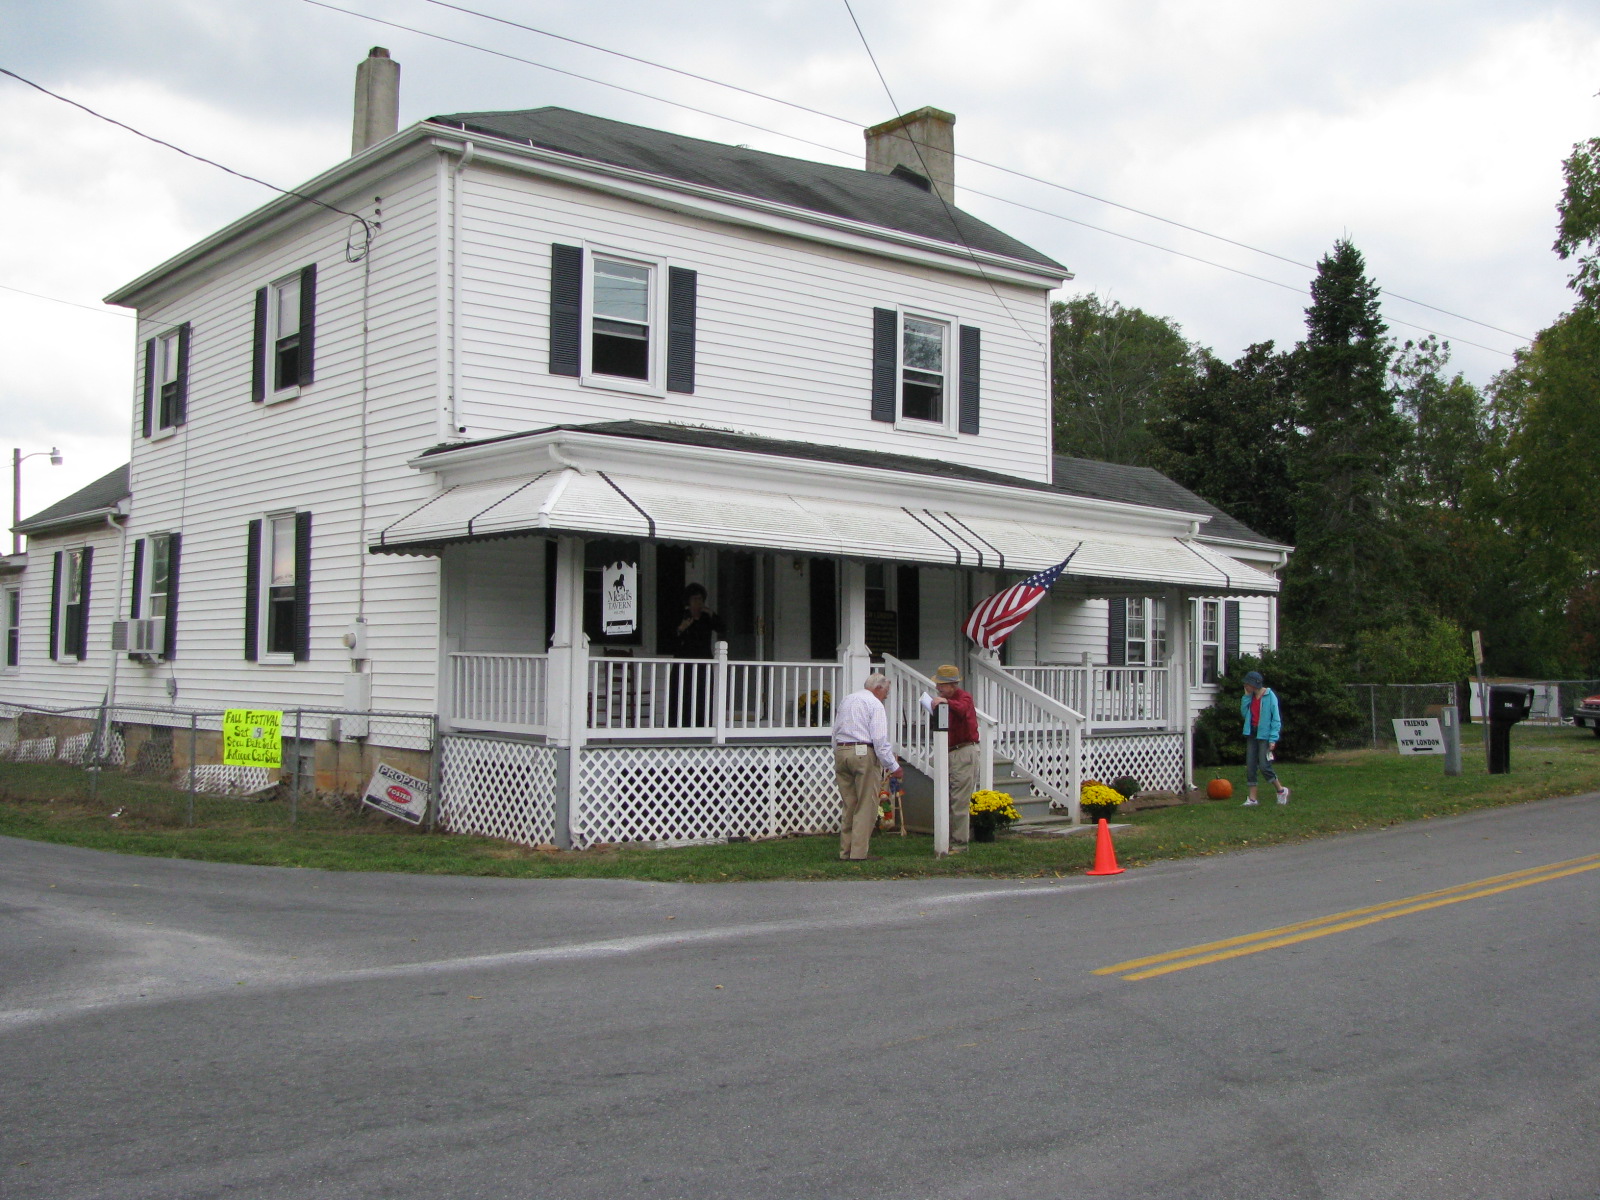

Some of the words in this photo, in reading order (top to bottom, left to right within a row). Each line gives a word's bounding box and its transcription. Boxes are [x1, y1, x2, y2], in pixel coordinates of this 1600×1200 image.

[608, 600, 632, 611] TAVERN
[225, 711, 243, 724] FALL
[245, 710, 279, 727] FESTIVAL
[387, 786, 412, 801] FOSTER
